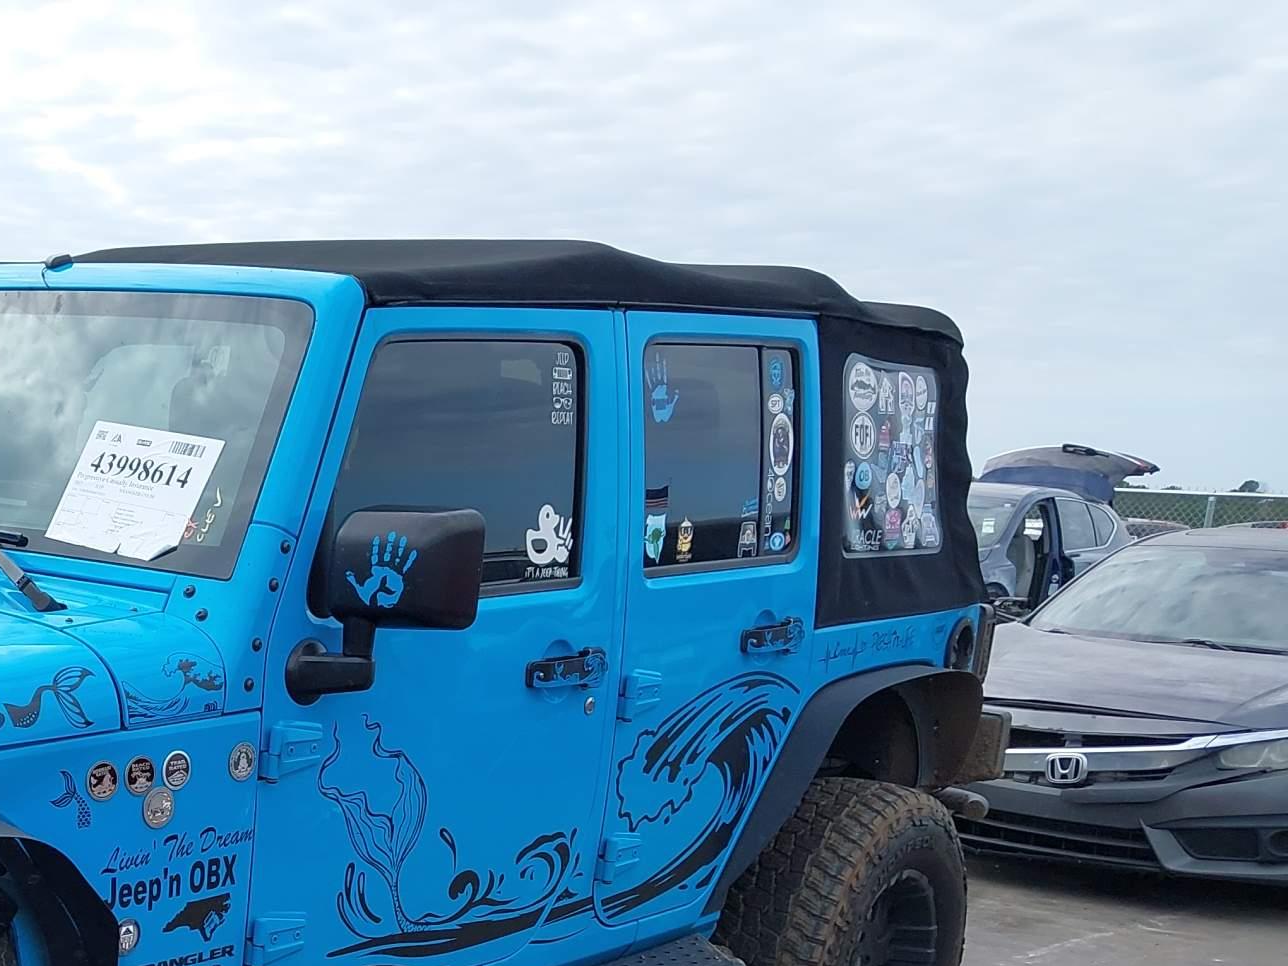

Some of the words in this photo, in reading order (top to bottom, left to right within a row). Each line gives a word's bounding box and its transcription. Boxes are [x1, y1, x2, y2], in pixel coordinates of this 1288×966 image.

[91, 451, 192, 488] 43998614
[101, 840, 156, 875] Livin'
[163, 832, 194, 862] The
[200, 826, 253, 853] Dream
[106, 868, 181, 911] Jeep'n
[189, 854, 237, 893] OBX
